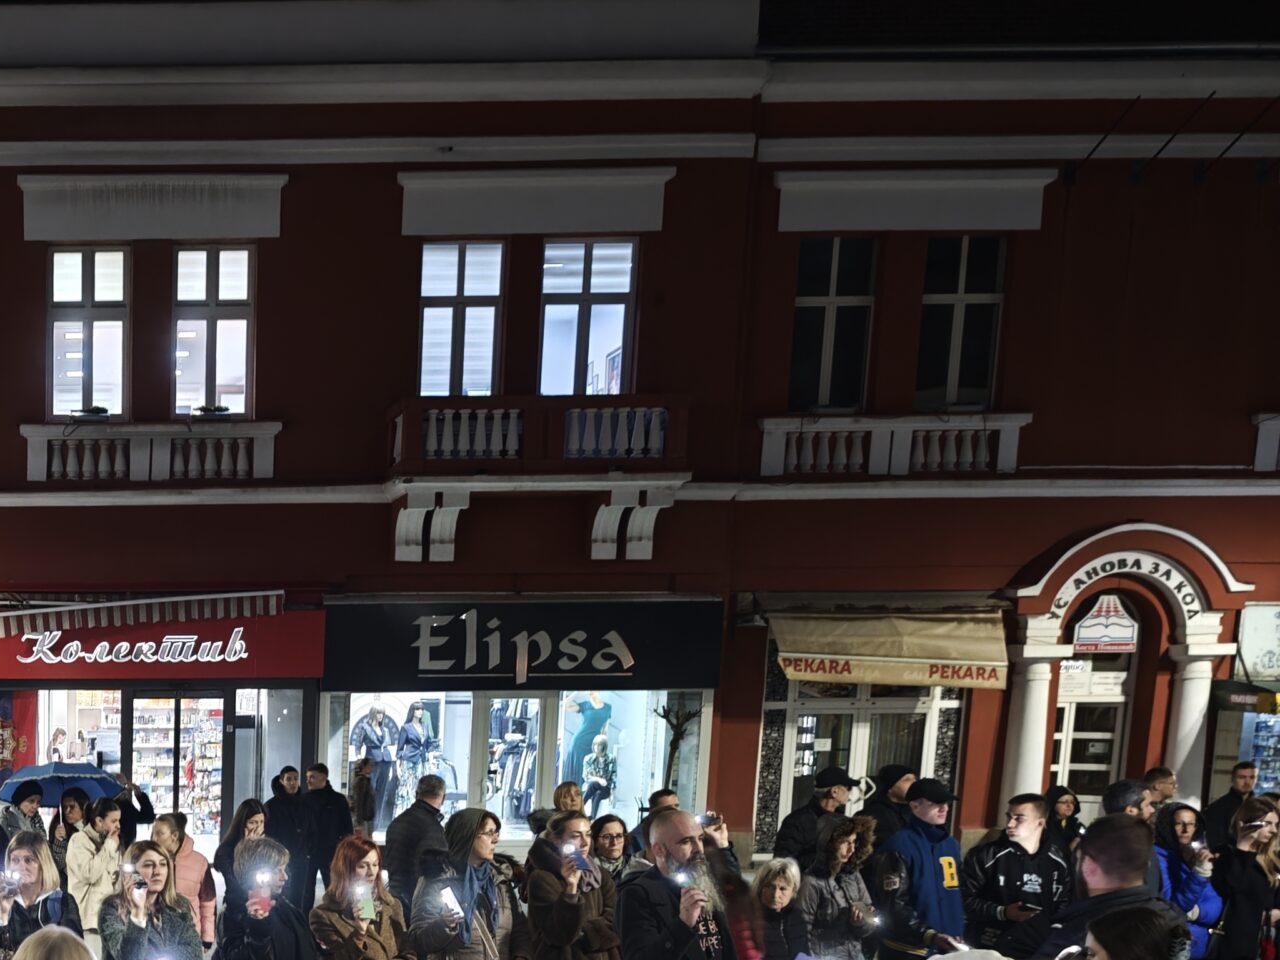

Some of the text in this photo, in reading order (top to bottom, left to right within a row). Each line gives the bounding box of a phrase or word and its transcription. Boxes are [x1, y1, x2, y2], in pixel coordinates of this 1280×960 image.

[1047, 558, 1142, 620] УСАНОВА
[1148, 562, 1173, 581] ЗА
[16, 627, 249, 663] Колектив
[410, 608, 636, 686] Elipsa
[782, 657, 852, 675] PEKARA
[928, 664, 999, 681] PEKARA
